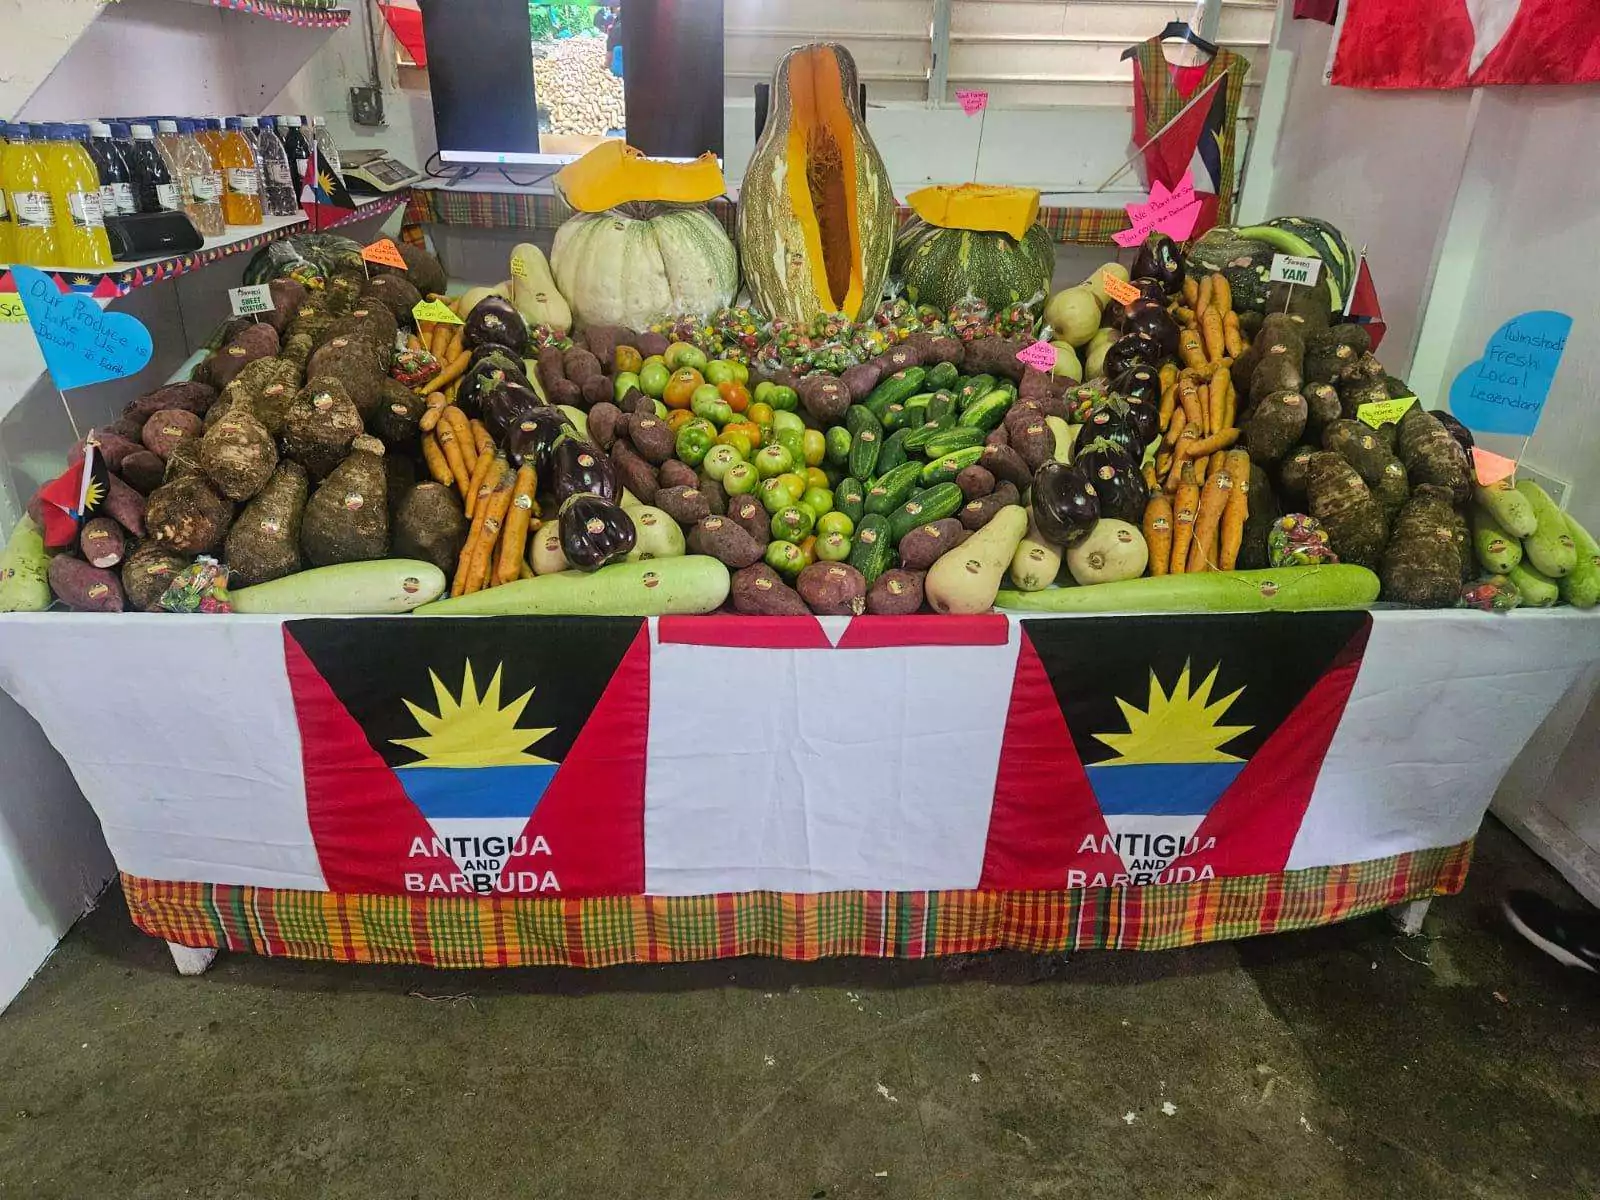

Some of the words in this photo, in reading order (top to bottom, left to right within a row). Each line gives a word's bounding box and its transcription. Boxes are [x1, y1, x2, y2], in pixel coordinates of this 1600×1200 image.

[1282, 267, 1308, 283] YAM
[31, 278, 62, 308] Our
[73, 298, 129, 348] Produce
[239, 302, 268, 314] POTATOES
[241, 296, 261, 306] SWEET
[1489, 345, 1540, 370] Fresh
[1477, 362, 1528, 389] Local
[1470, 383, 1541, 413] Legendary
[408, 835, 552, 859] ANTIGUA
[1077, 833, 1217, 859] ANTIGUA
[463, 859, 500, 872] AND
[1066, 864, 1216, 890] BARBUDA
[1130, 859, 1167, 872] AND
[404, 870, 561, 896] BARBUDA
